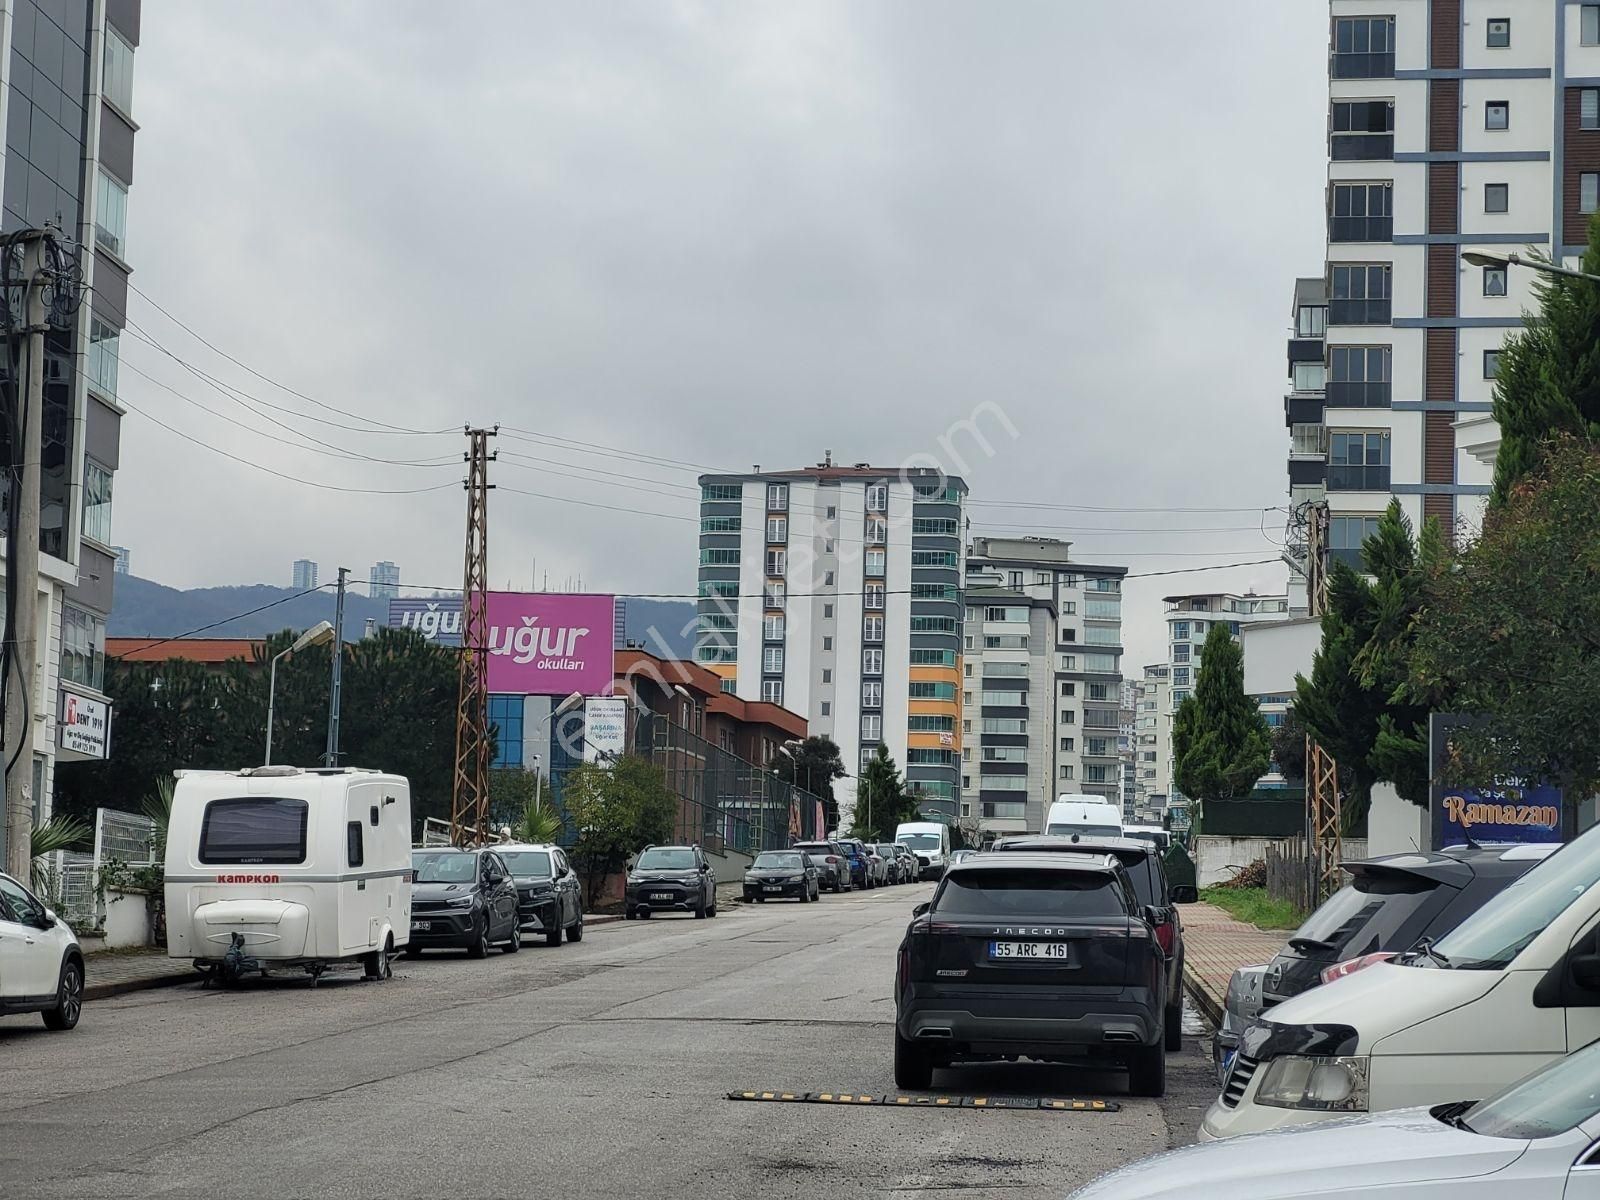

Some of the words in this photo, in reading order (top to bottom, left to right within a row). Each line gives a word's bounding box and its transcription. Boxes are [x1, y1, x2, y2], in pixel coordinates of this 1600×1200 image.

[402, 603, 463, 639] uğu
[488, 616, 590, 664] uğur
[537, 658, 584, 670] okulları
[76, 713, 90, 726] DENT
[92, 718, 102, 730] 1919
[1443, 796, 1558, 831] Ramazan
[993, 927, 1065, 935] JAECOO
[997, 943, 1011, 956] 55
[1016, 943, 1038, 957] ARC
[1045, 944, 1065, 957] 416
